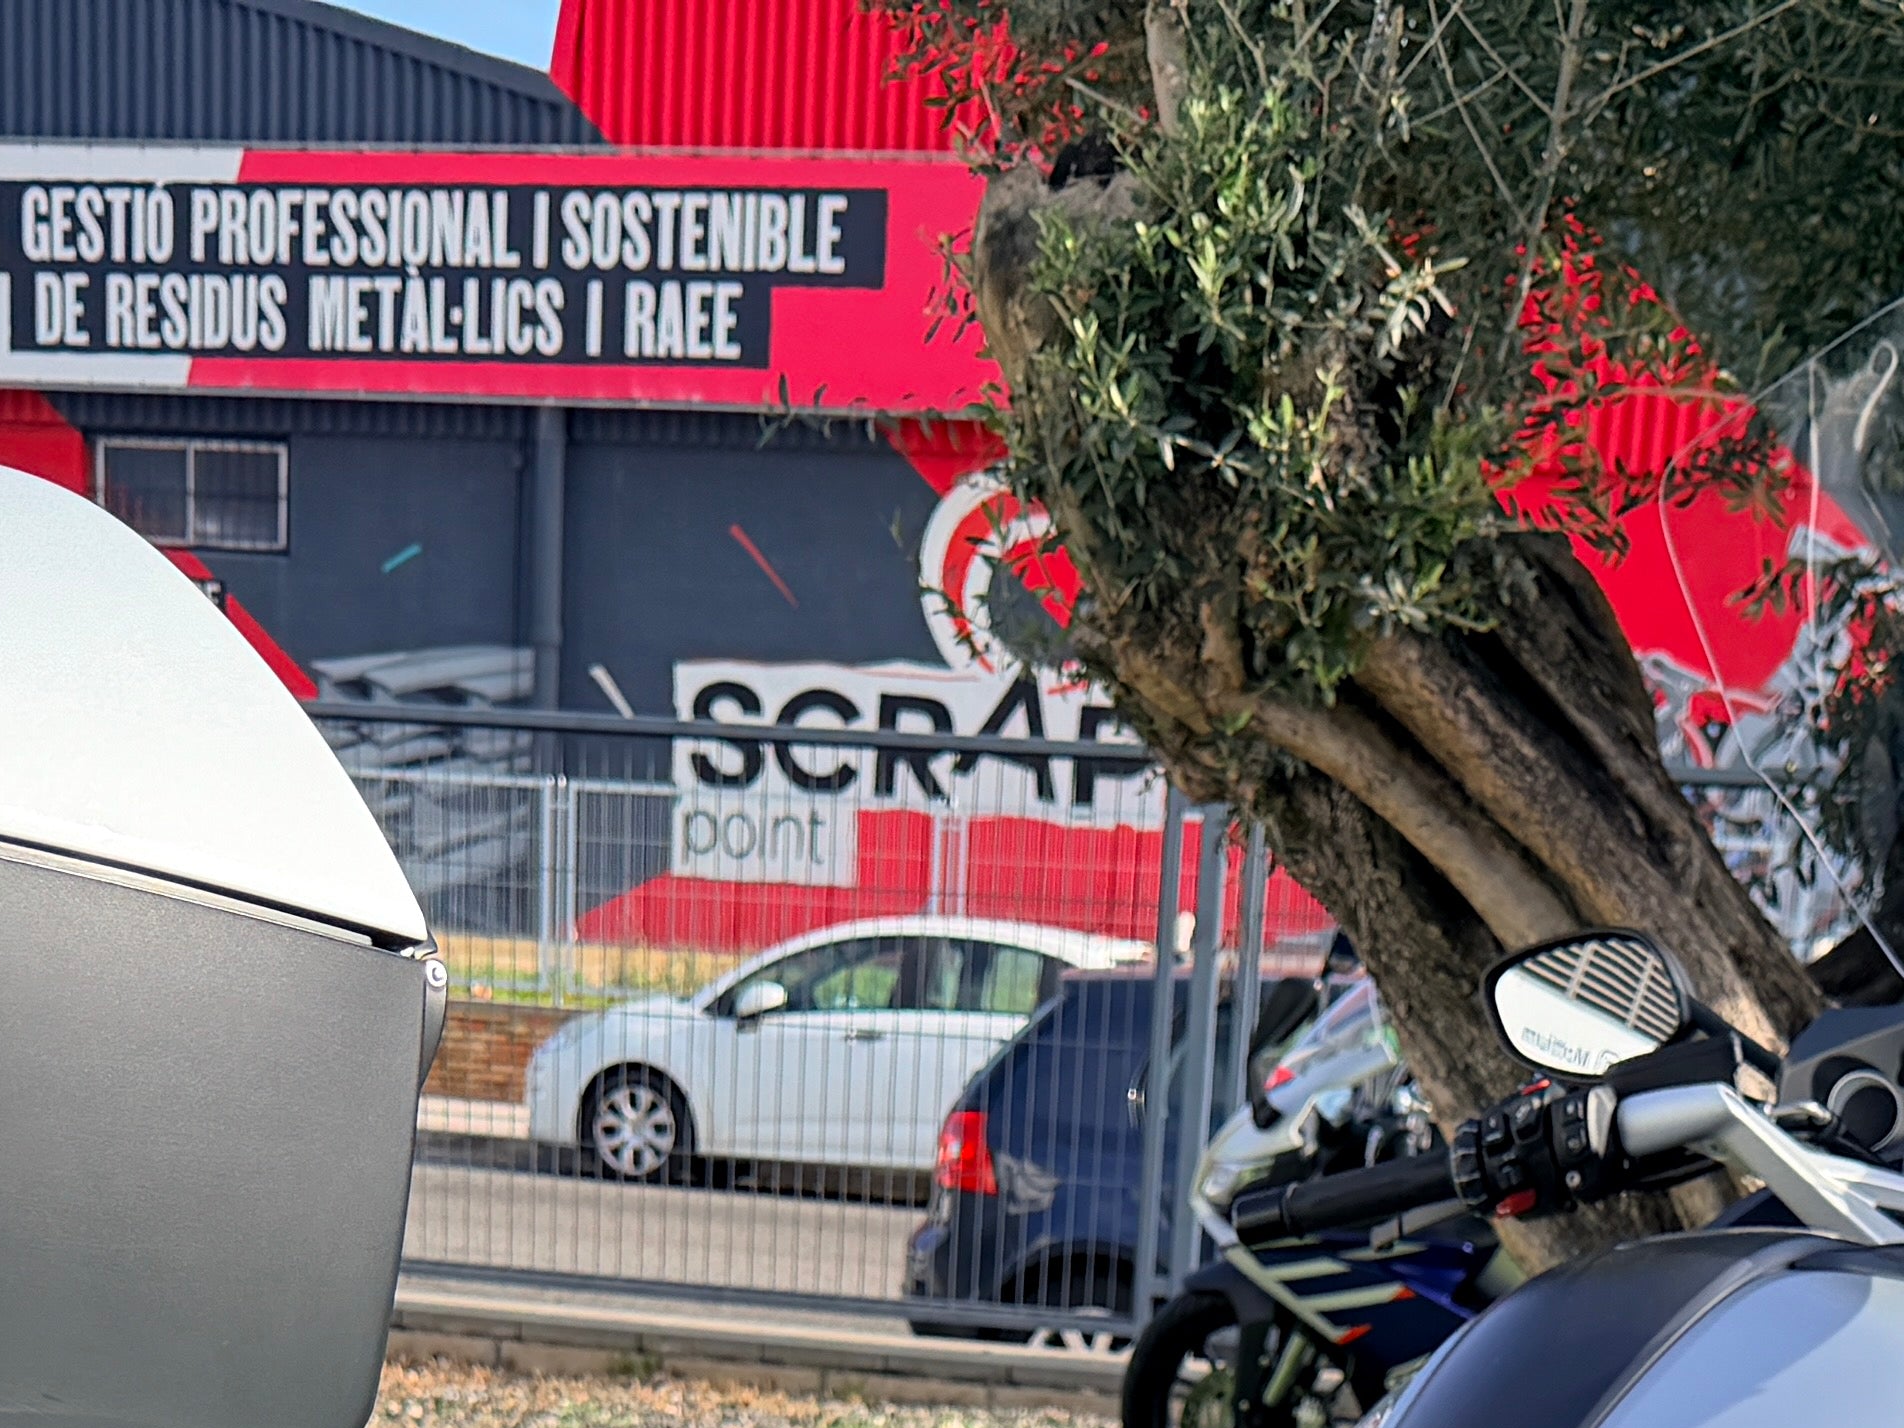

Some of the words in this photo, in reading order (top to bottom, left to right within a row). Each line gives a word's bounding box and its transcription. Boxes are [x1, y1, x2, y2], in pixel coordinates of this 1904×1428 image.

[190, 188, 520, 267] PROFESSIONAL
[533, 190, 550, 270] I
[561, 190, 847, 274] SOSTENIBLE
[34, 270, 90, 347] DE
[106, 272, 287, 352] RESIDUS
[585, 279, 603, 357] I
[624, 281, 743, 359] RAEE
[683, 807, 825, 865] point
